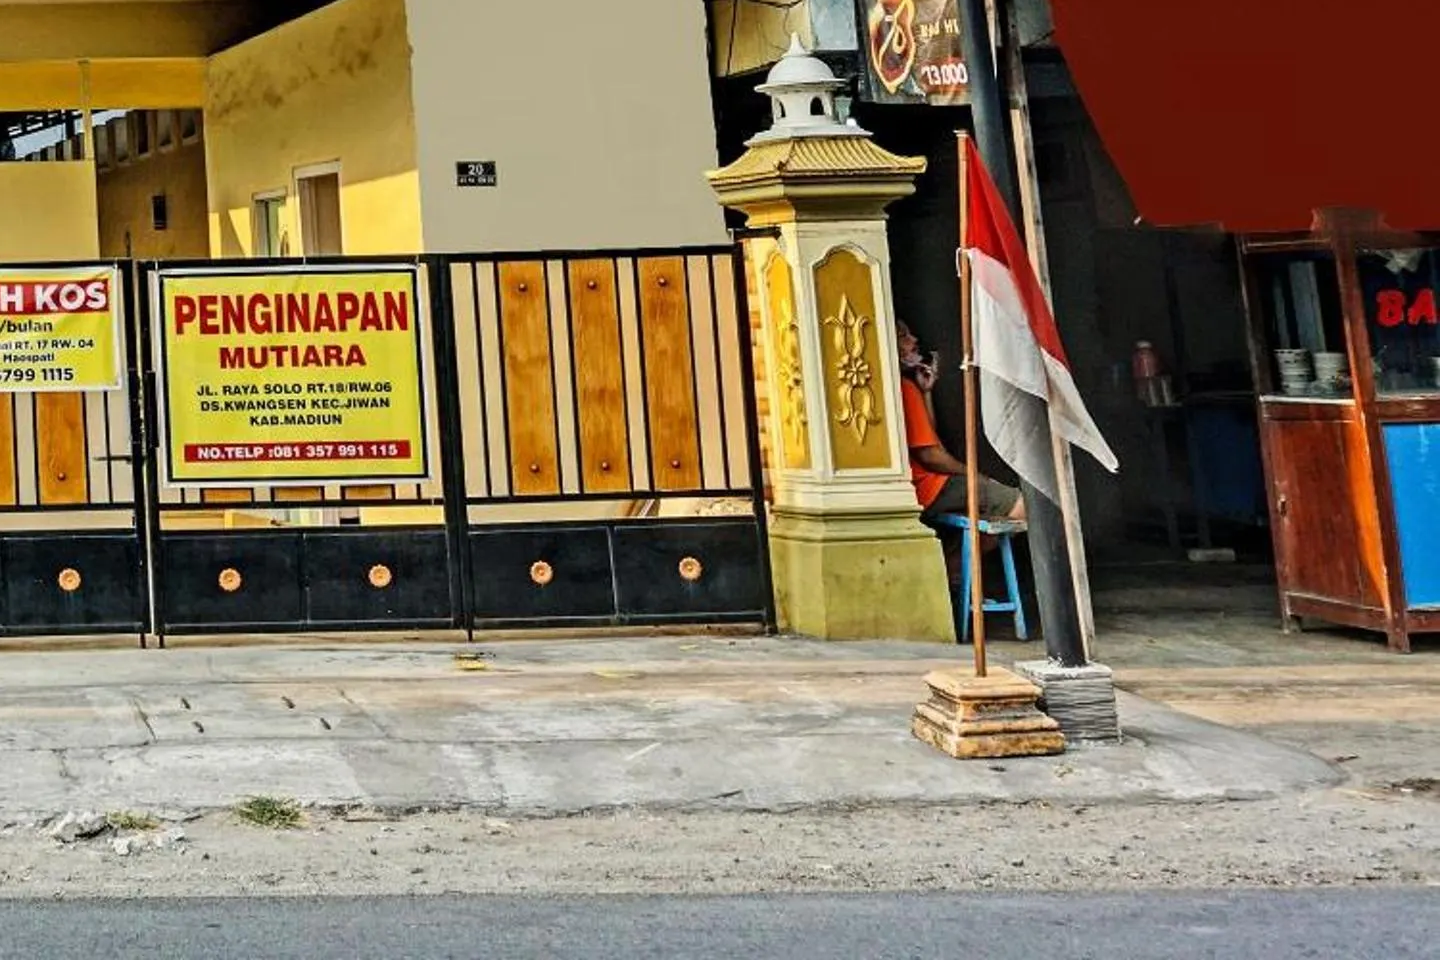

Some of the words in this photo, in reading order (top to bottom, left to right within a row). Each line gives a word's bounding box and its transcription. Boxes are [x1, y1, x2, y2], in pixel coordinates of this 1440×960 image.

[468, 163, 484, 176] 20
[34, 281, 107, 312] KOS
[174, 291, 408, 335] PENGINAPAN
[15, 341, 33, 350] RT.
[37, 340, 48, 350] 17
[52, 339, 75, 349] RW.
[78, 339, 94, 349] 04
[3, 352, 54, 364] Maospati
[220, 344, 366, 369] MUTIARA
[42, 367, 74, 381] 1115
[197, 385, 218, 396] JL.
[222, 384, 259, 396] RAYA
[264, 383, 302, 394] SOLO
[201, 399, 306, 411] DS.KWANGSEN
[311, 397, 390, 409] KEC.JIWAN
[250, 414, 342, 426] KAB.MADIUN
[197, 446, 264, 459] NO.TELP
[306, 444, 333, 458] 357
[338, 444, 364, 457] 991
[371, 443, 398, 456] 115
